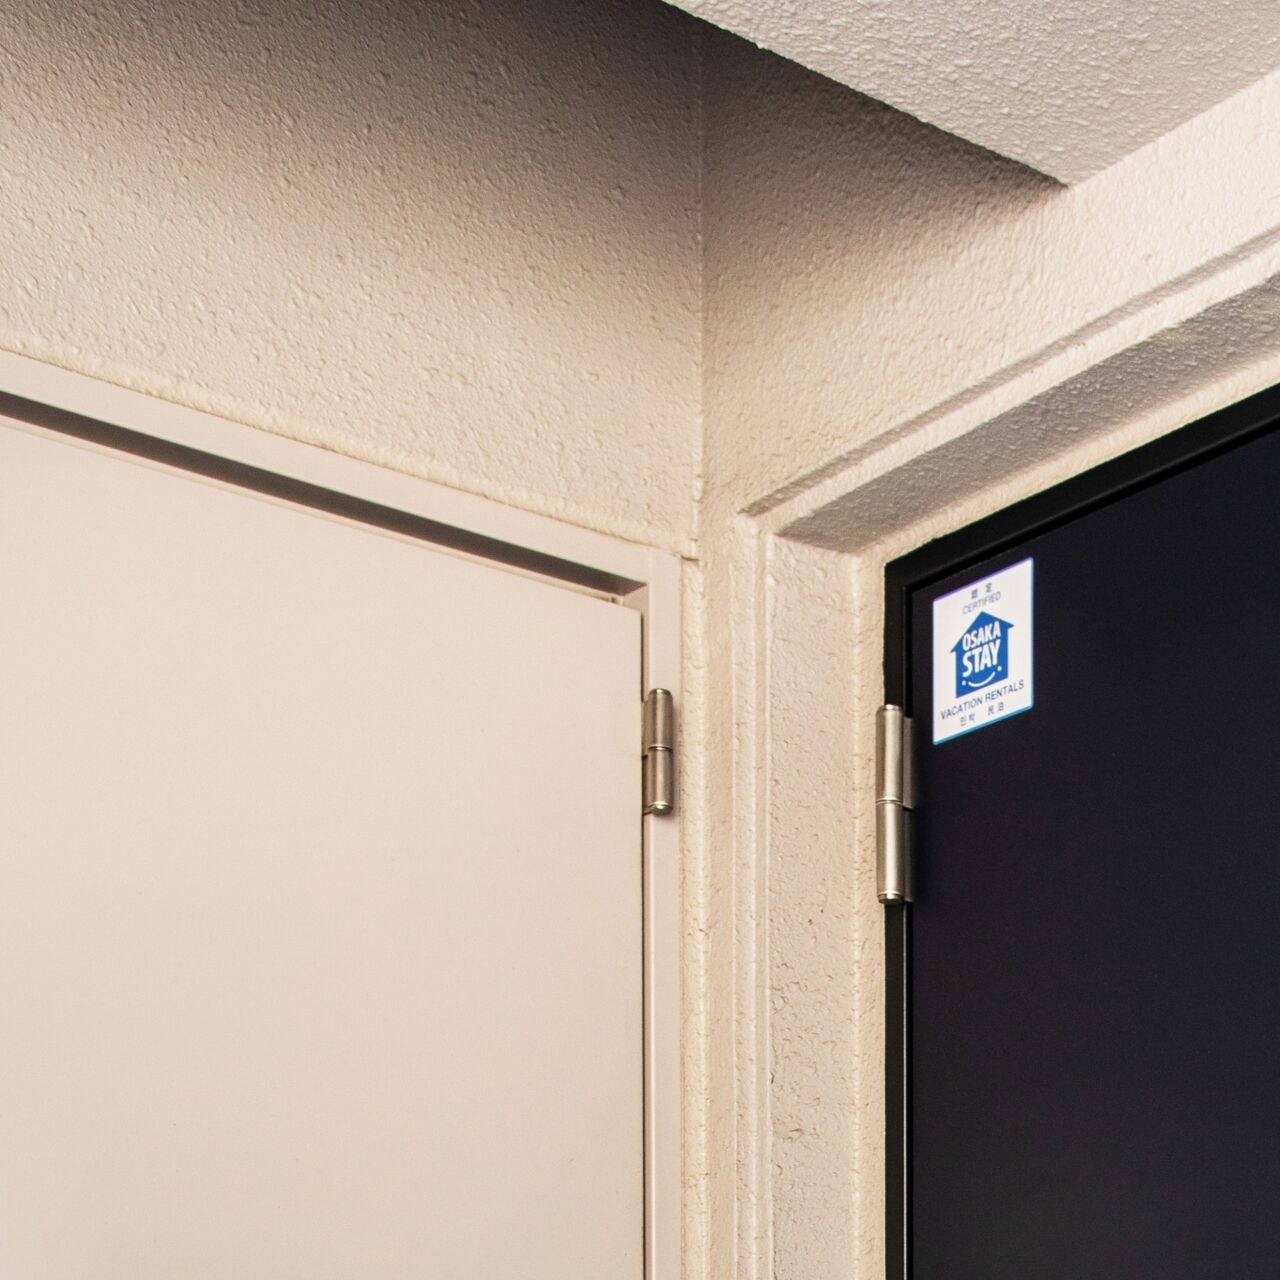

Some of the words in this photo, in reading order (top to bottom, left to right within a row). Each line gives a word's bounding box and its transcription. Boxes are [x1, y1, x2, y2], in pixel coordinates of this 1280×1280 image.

[962, 591, 1002, 615] CERTIFIED
[961, 620, 1002, 652] OSAKA
[961, 638, 1001, 677] STAY
[940, 695, 983, 720] VACATION
[985, 679, 1025, 703] RENTALS
